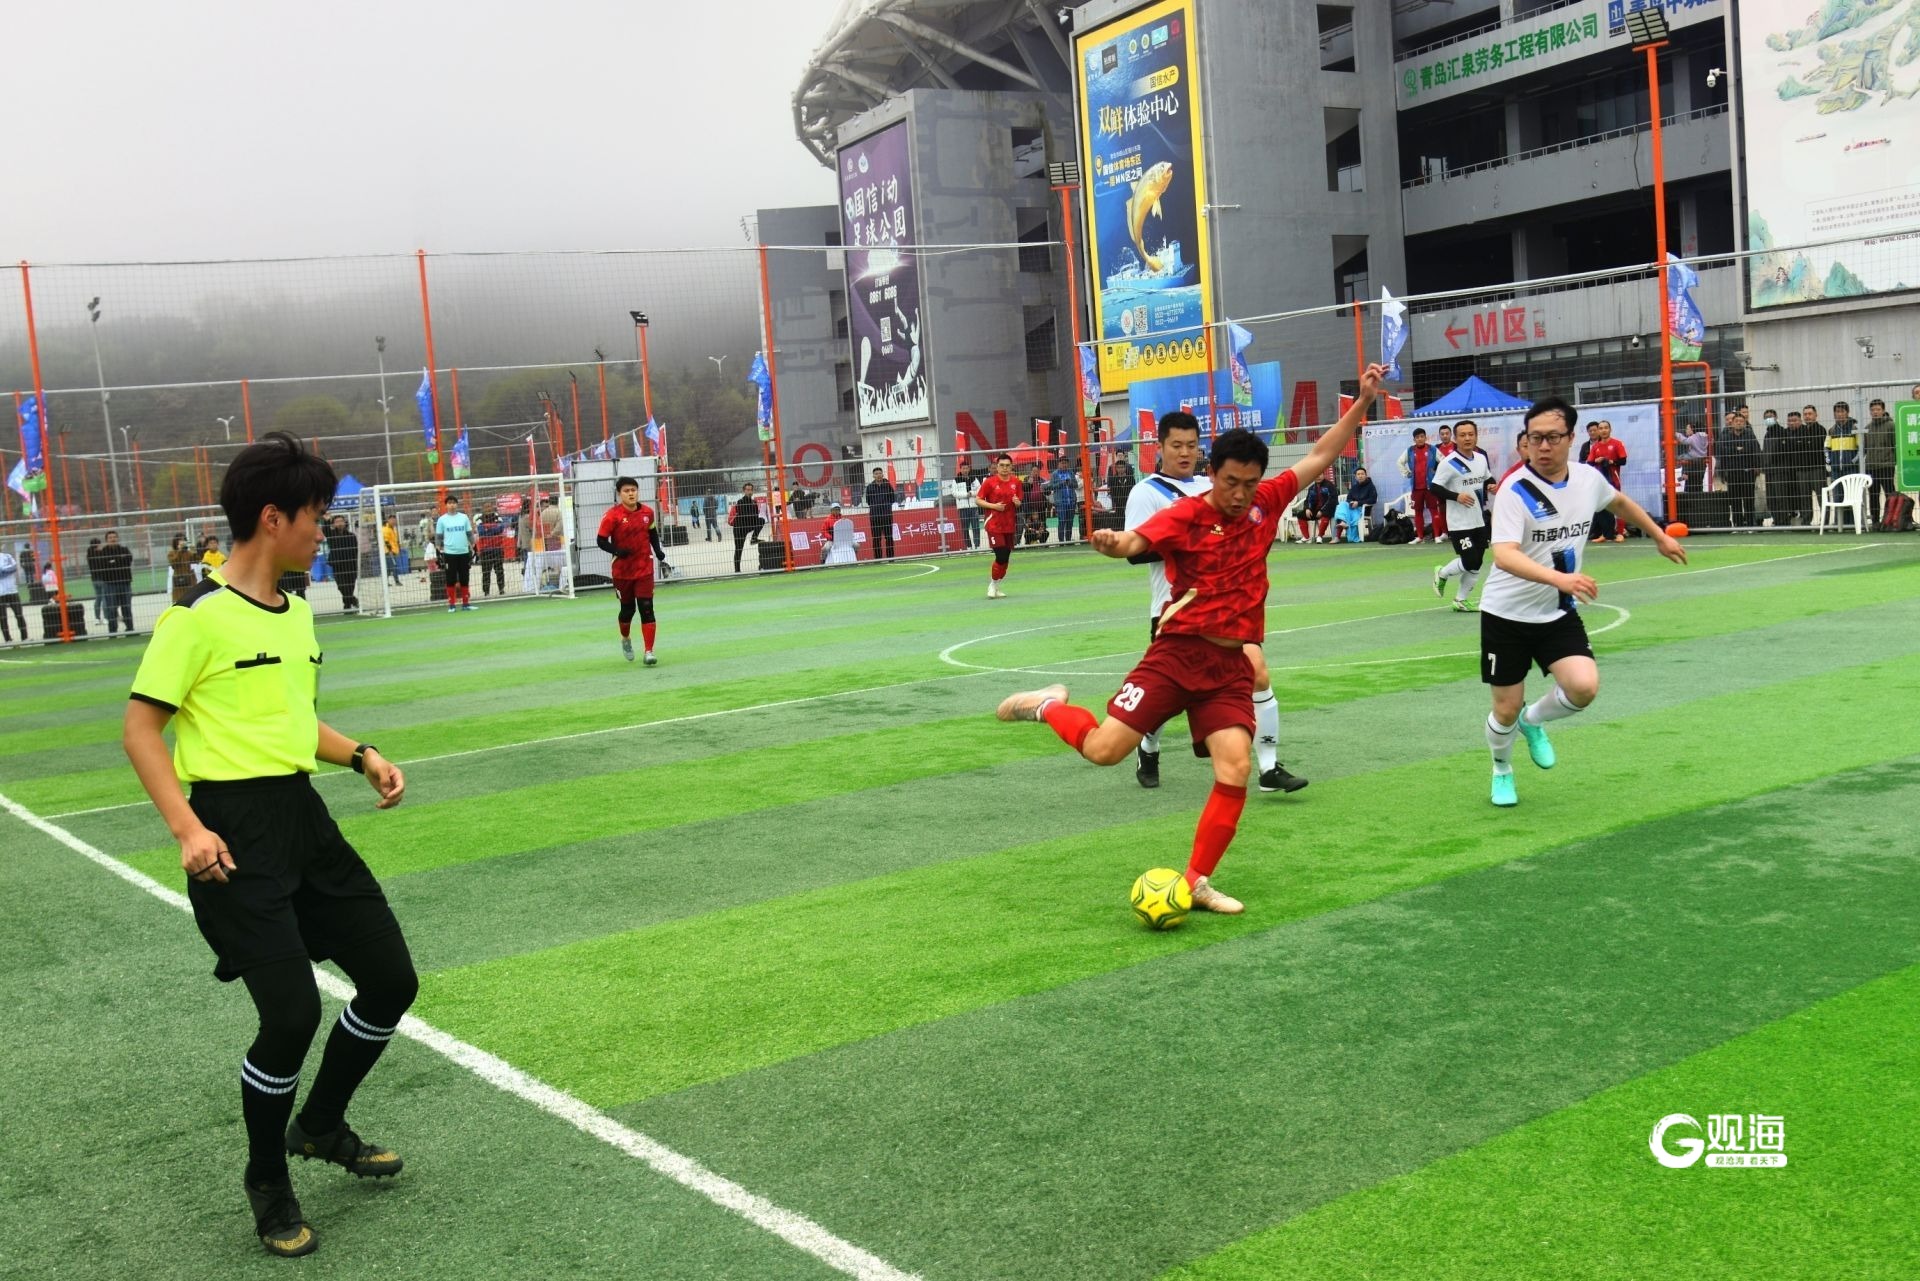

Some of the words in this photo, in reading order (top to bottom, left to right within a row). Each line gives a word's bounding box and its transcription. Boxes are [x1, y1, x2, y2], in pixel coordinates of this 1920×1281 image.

[1420, 13, 1598, 90] 青岛汇泉劳务工程有限公司
[1150, 69, 1176, 89] 国信水产
[1097, 91, 1179, 138] 双鲜体验中心
[854, 206, 906, 246] 足球公园
[1460, 537, 1472, 550] 26
[1488, 653, 1496, 675] 7
[1114, 682, 1145, 712] 29
